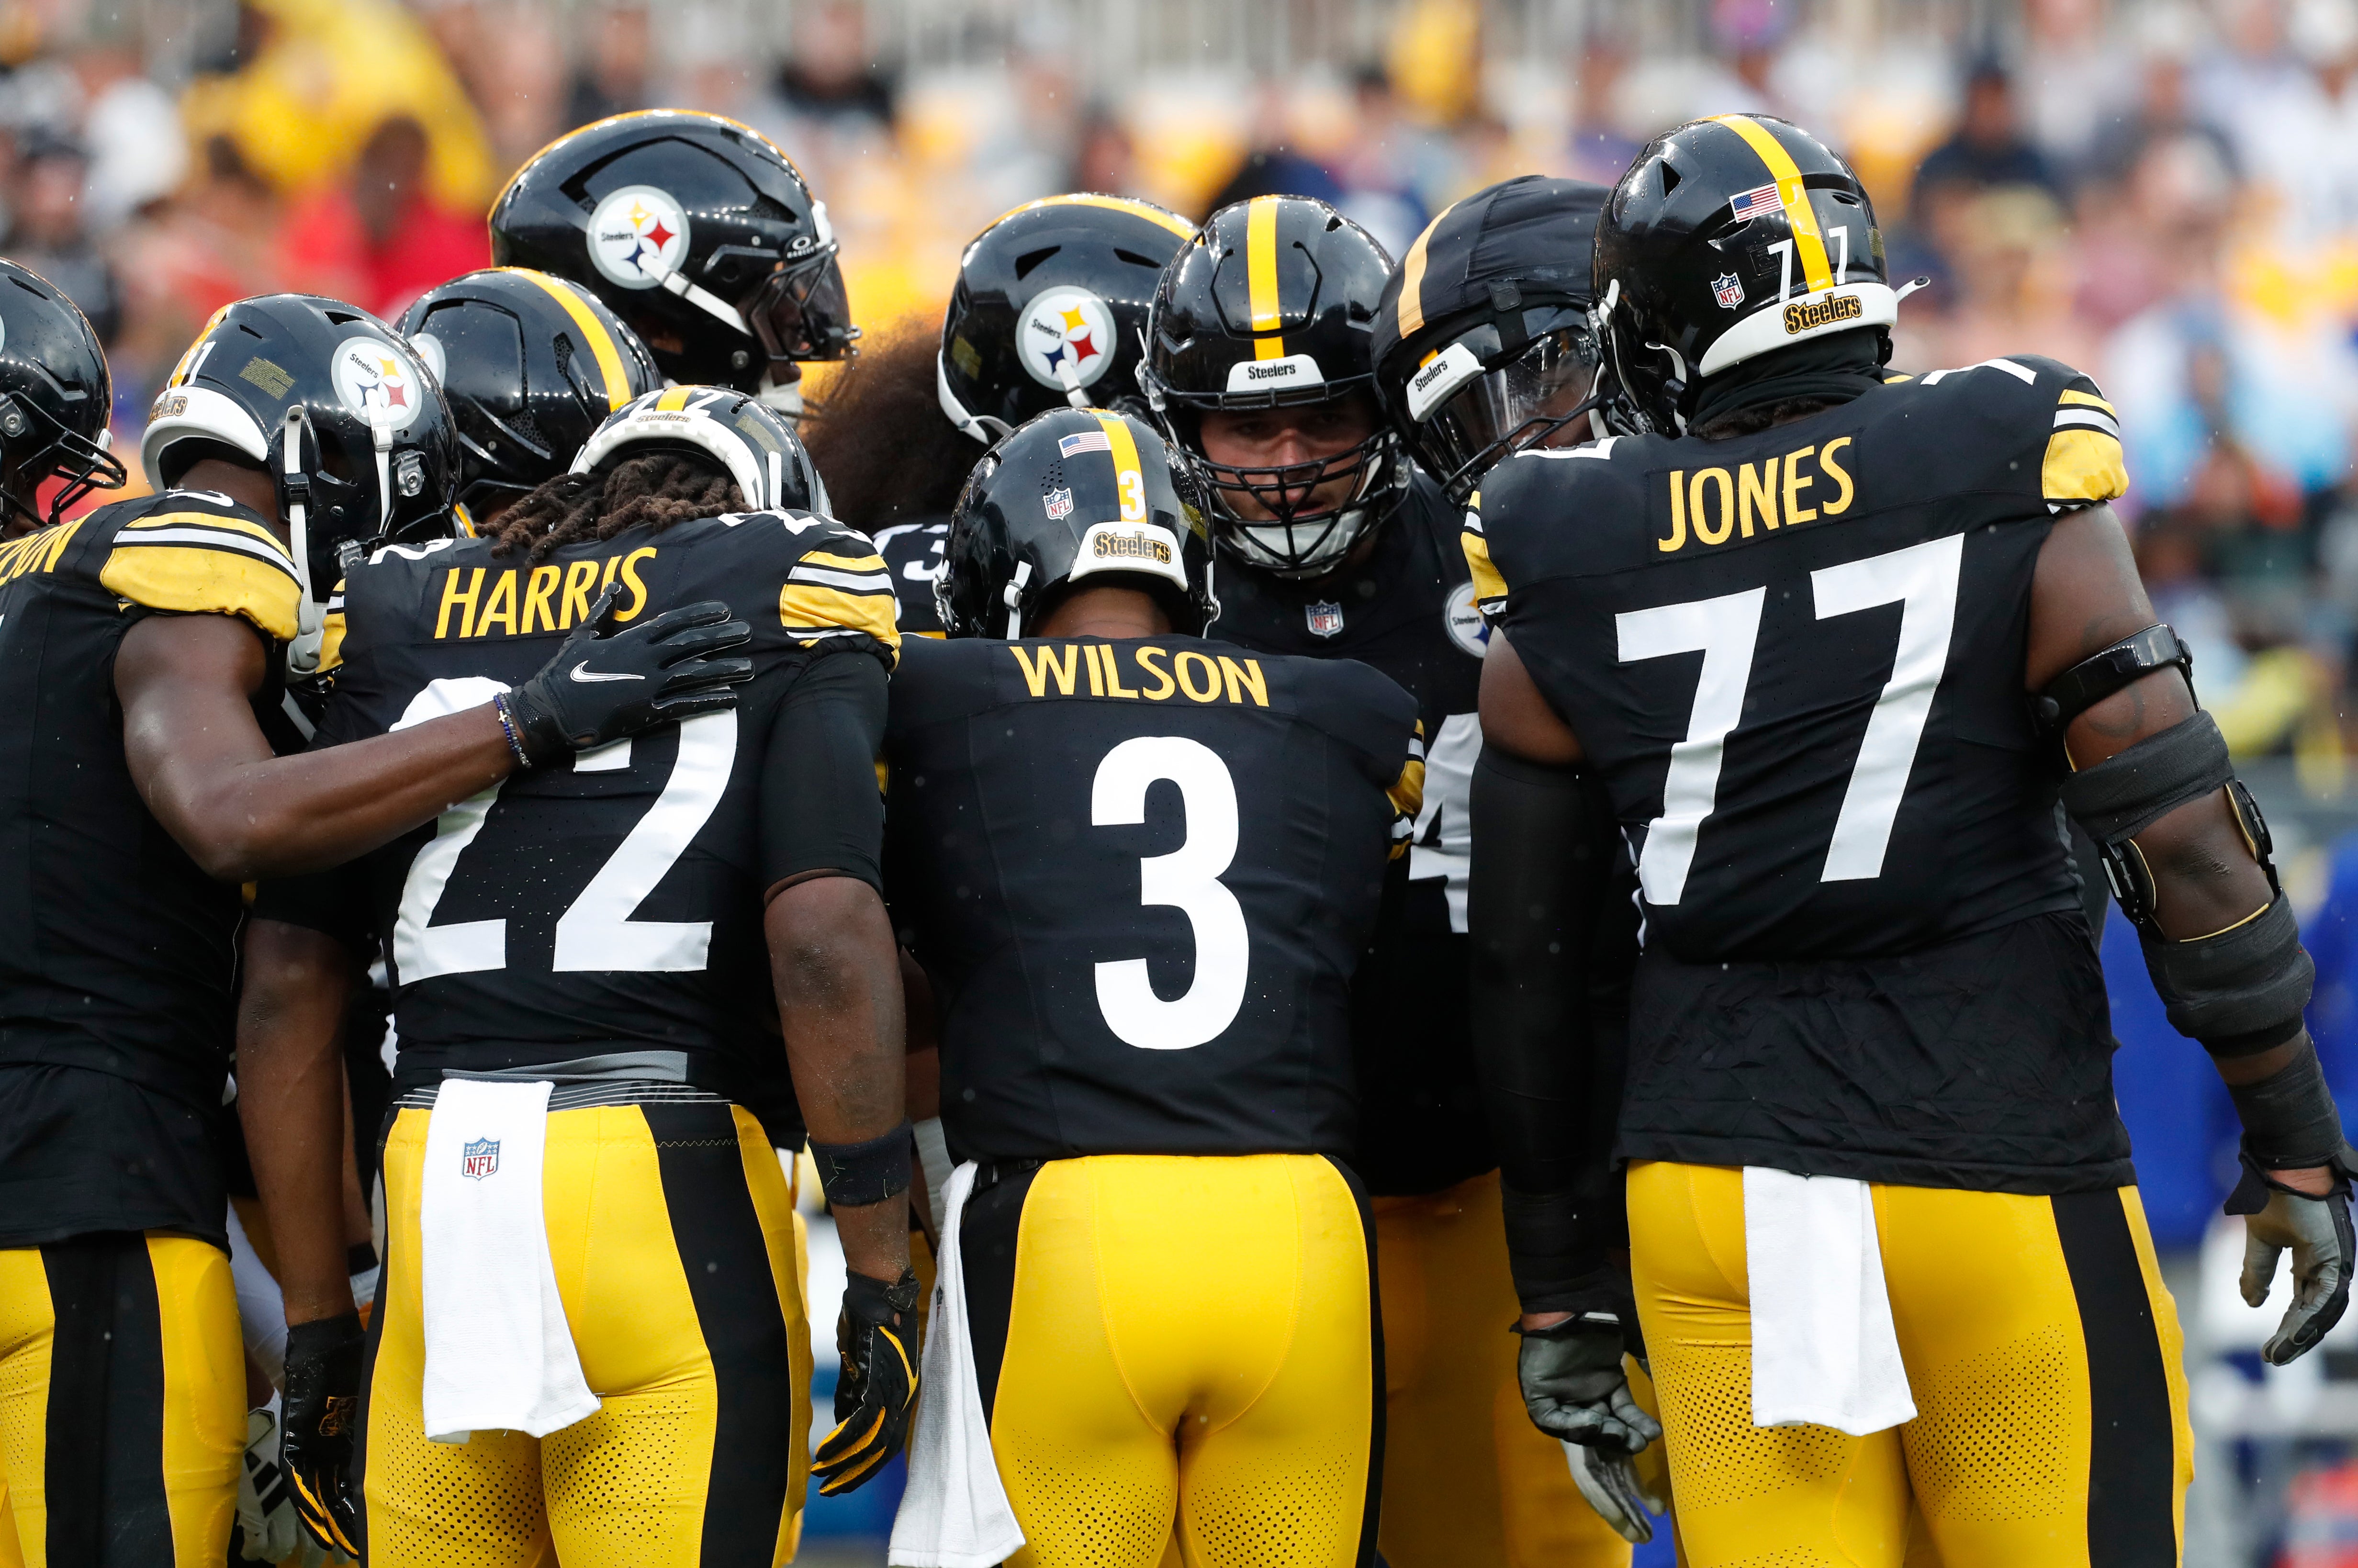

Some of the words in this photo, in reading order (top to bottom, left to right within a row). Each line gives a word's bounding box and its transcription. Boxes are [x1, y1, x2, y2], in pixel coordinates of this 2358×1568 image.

[601, 232, 634, 242] Steelers
[1719, 287, 1741, 303] NFL
[1031, 319, 1061, 339] Steelers
[1783, 292, 1862, 334] Steelers
[349, 353, 379, 379] Steelers
[1247, 361, 1296, 381] Steelers
[1415, 358, 1448, 392] Steelers
[1050, 502, 1070, 515] NFL
[1119, 470, 1146, 520] 3
[1658, 436, 1854, 551] JONES
[1094, 531, 1171, 564] Steelers
[435, 547, 657, 639] HARRIS
[1314, 615, 1337, 630] NFL
[1452, 616, 1480, 626] Steelers
[1009, 644, 1269, 707] WILSON
[1616, 532, 1965, 906] 77
[393, 676, 738, 986] 22
[1091, 736, 1249, 1050] 3
[466, 1156, 494, 1176] NFL
